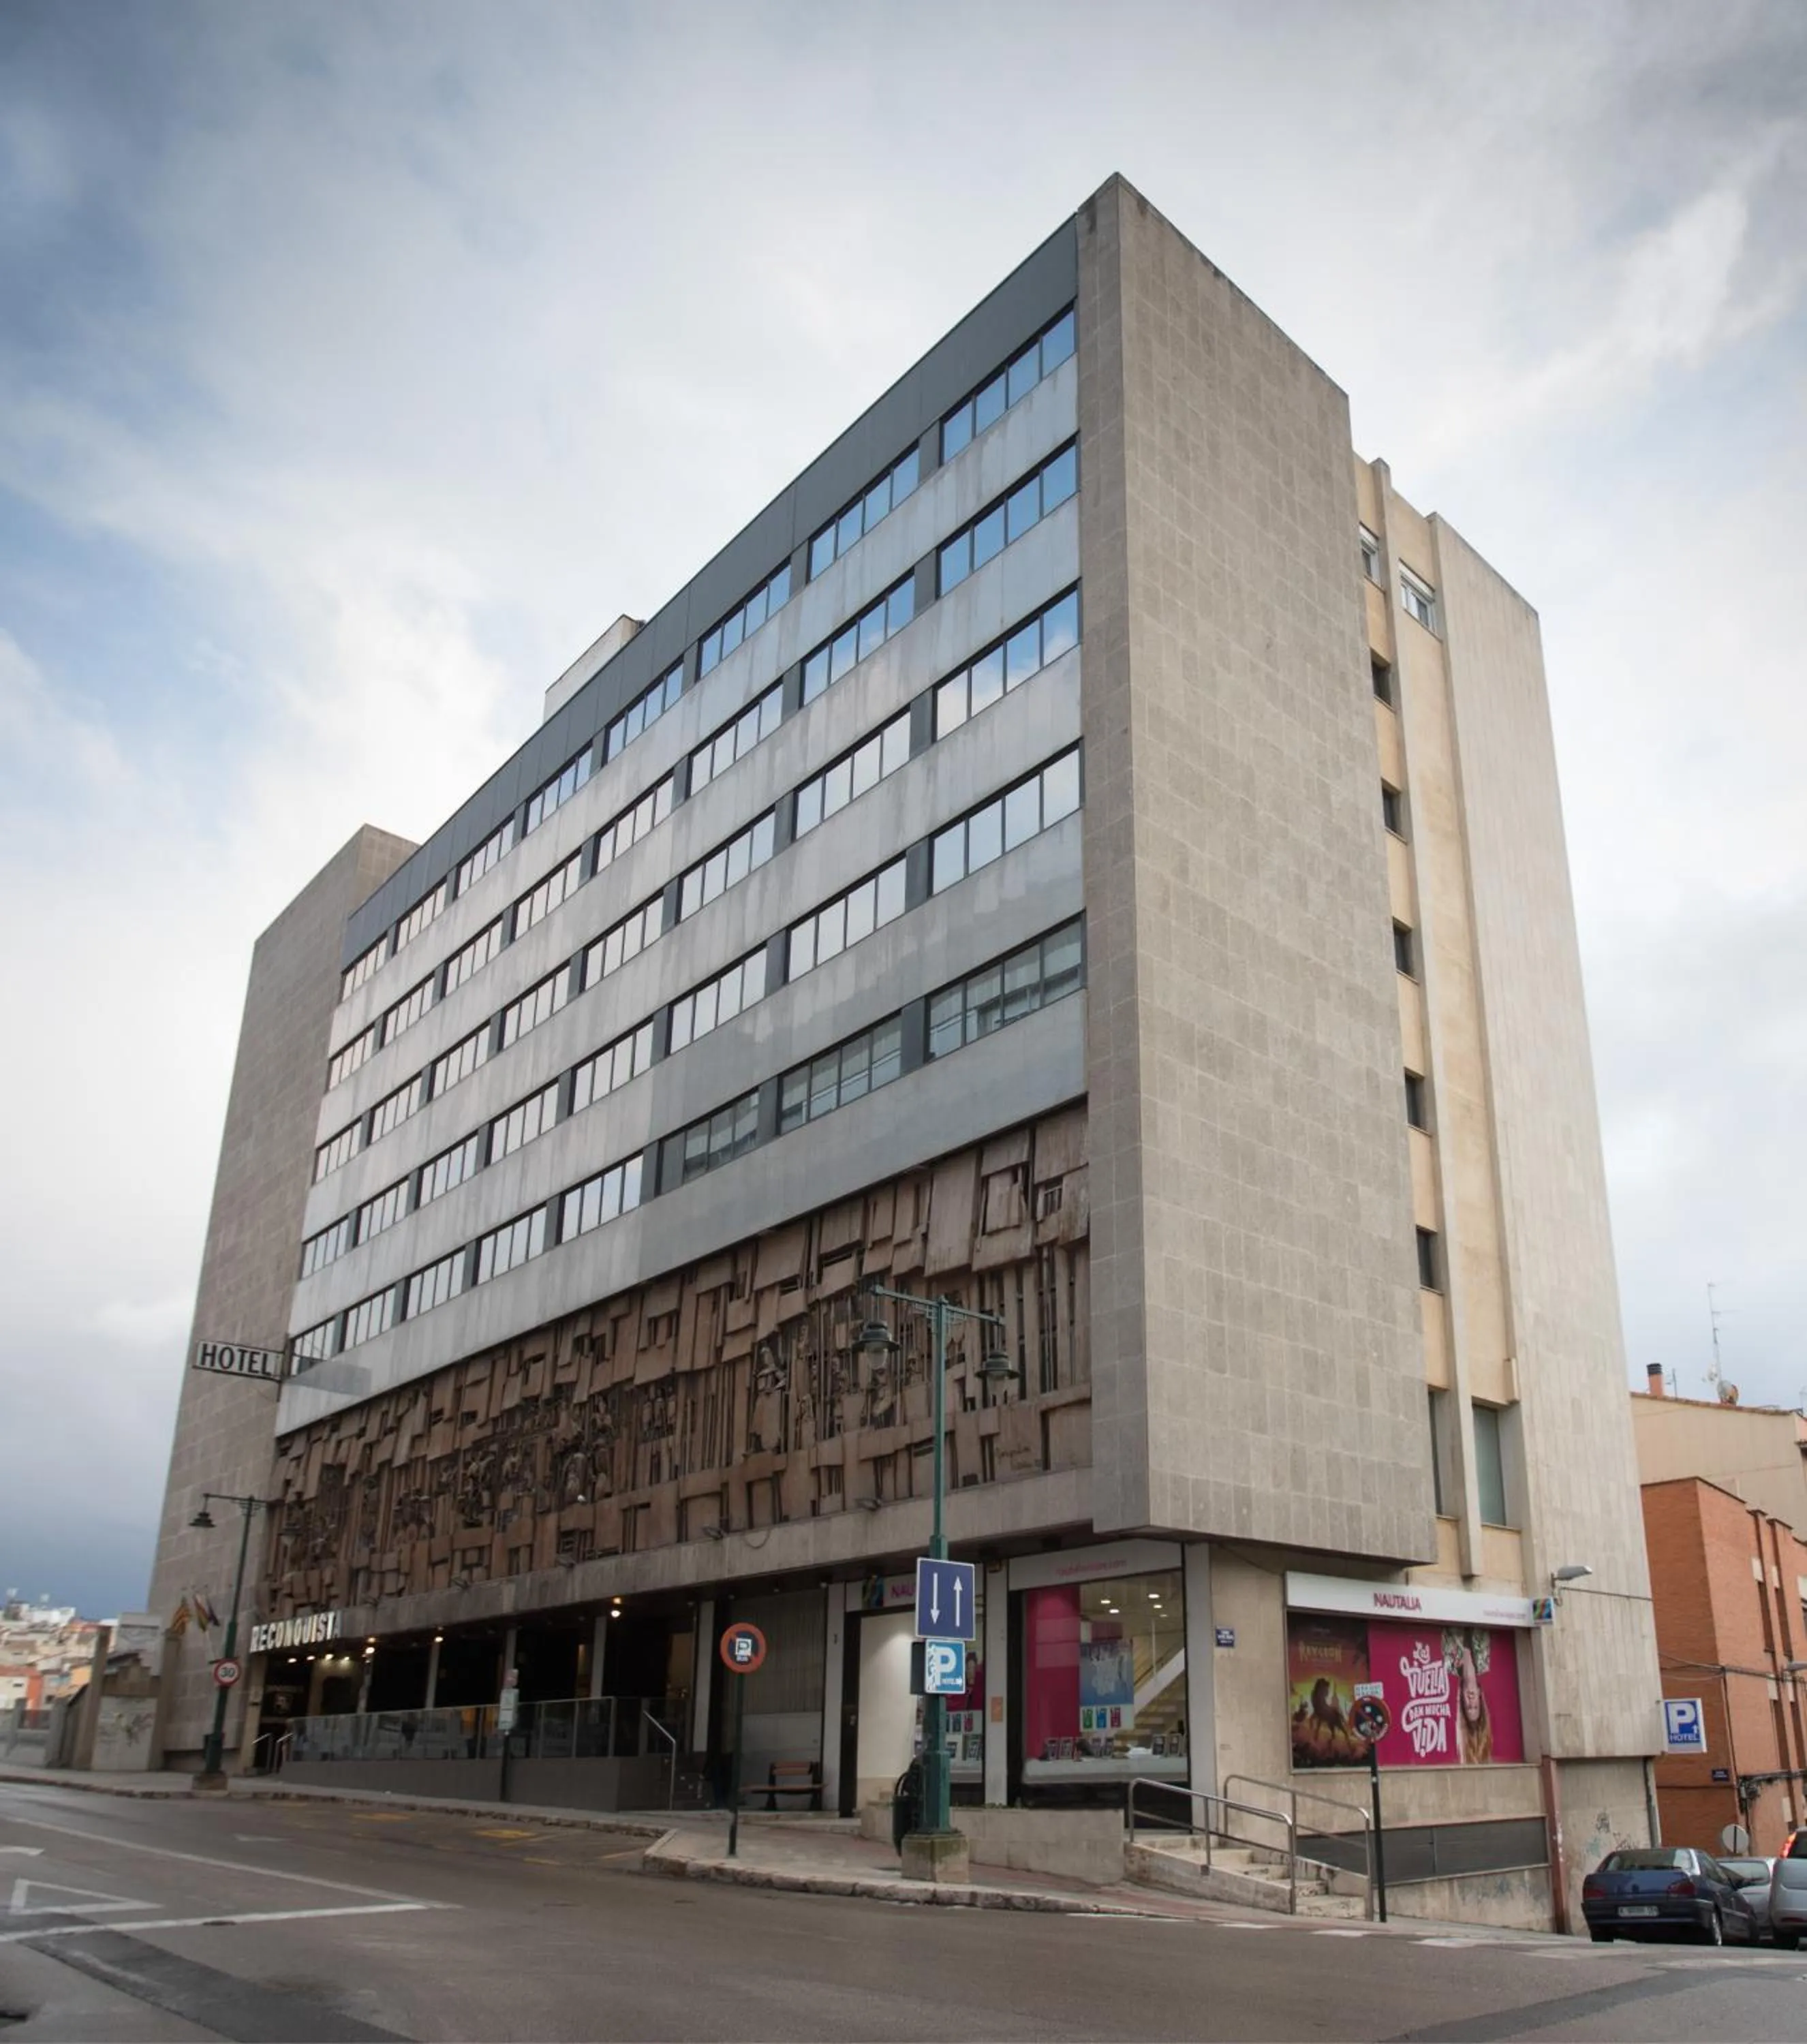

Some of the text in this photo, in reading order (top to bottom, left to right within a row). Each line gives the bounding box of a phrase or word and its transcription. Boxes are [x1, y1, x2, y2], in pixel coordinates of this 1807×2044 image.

[200, 1343, 272, 1376] HOTEL
[1373, 1592, 1423, 1613] NAUTALIA
[249, 1611, 342, 1653] RECONQUISTA
[219, 1667, 235, 1678] 30
[934, 1646, 957, 1686] P
[1668, 1703, 1696, 1734] P
[1669, 1732, 1701, 1743] HOTEL
